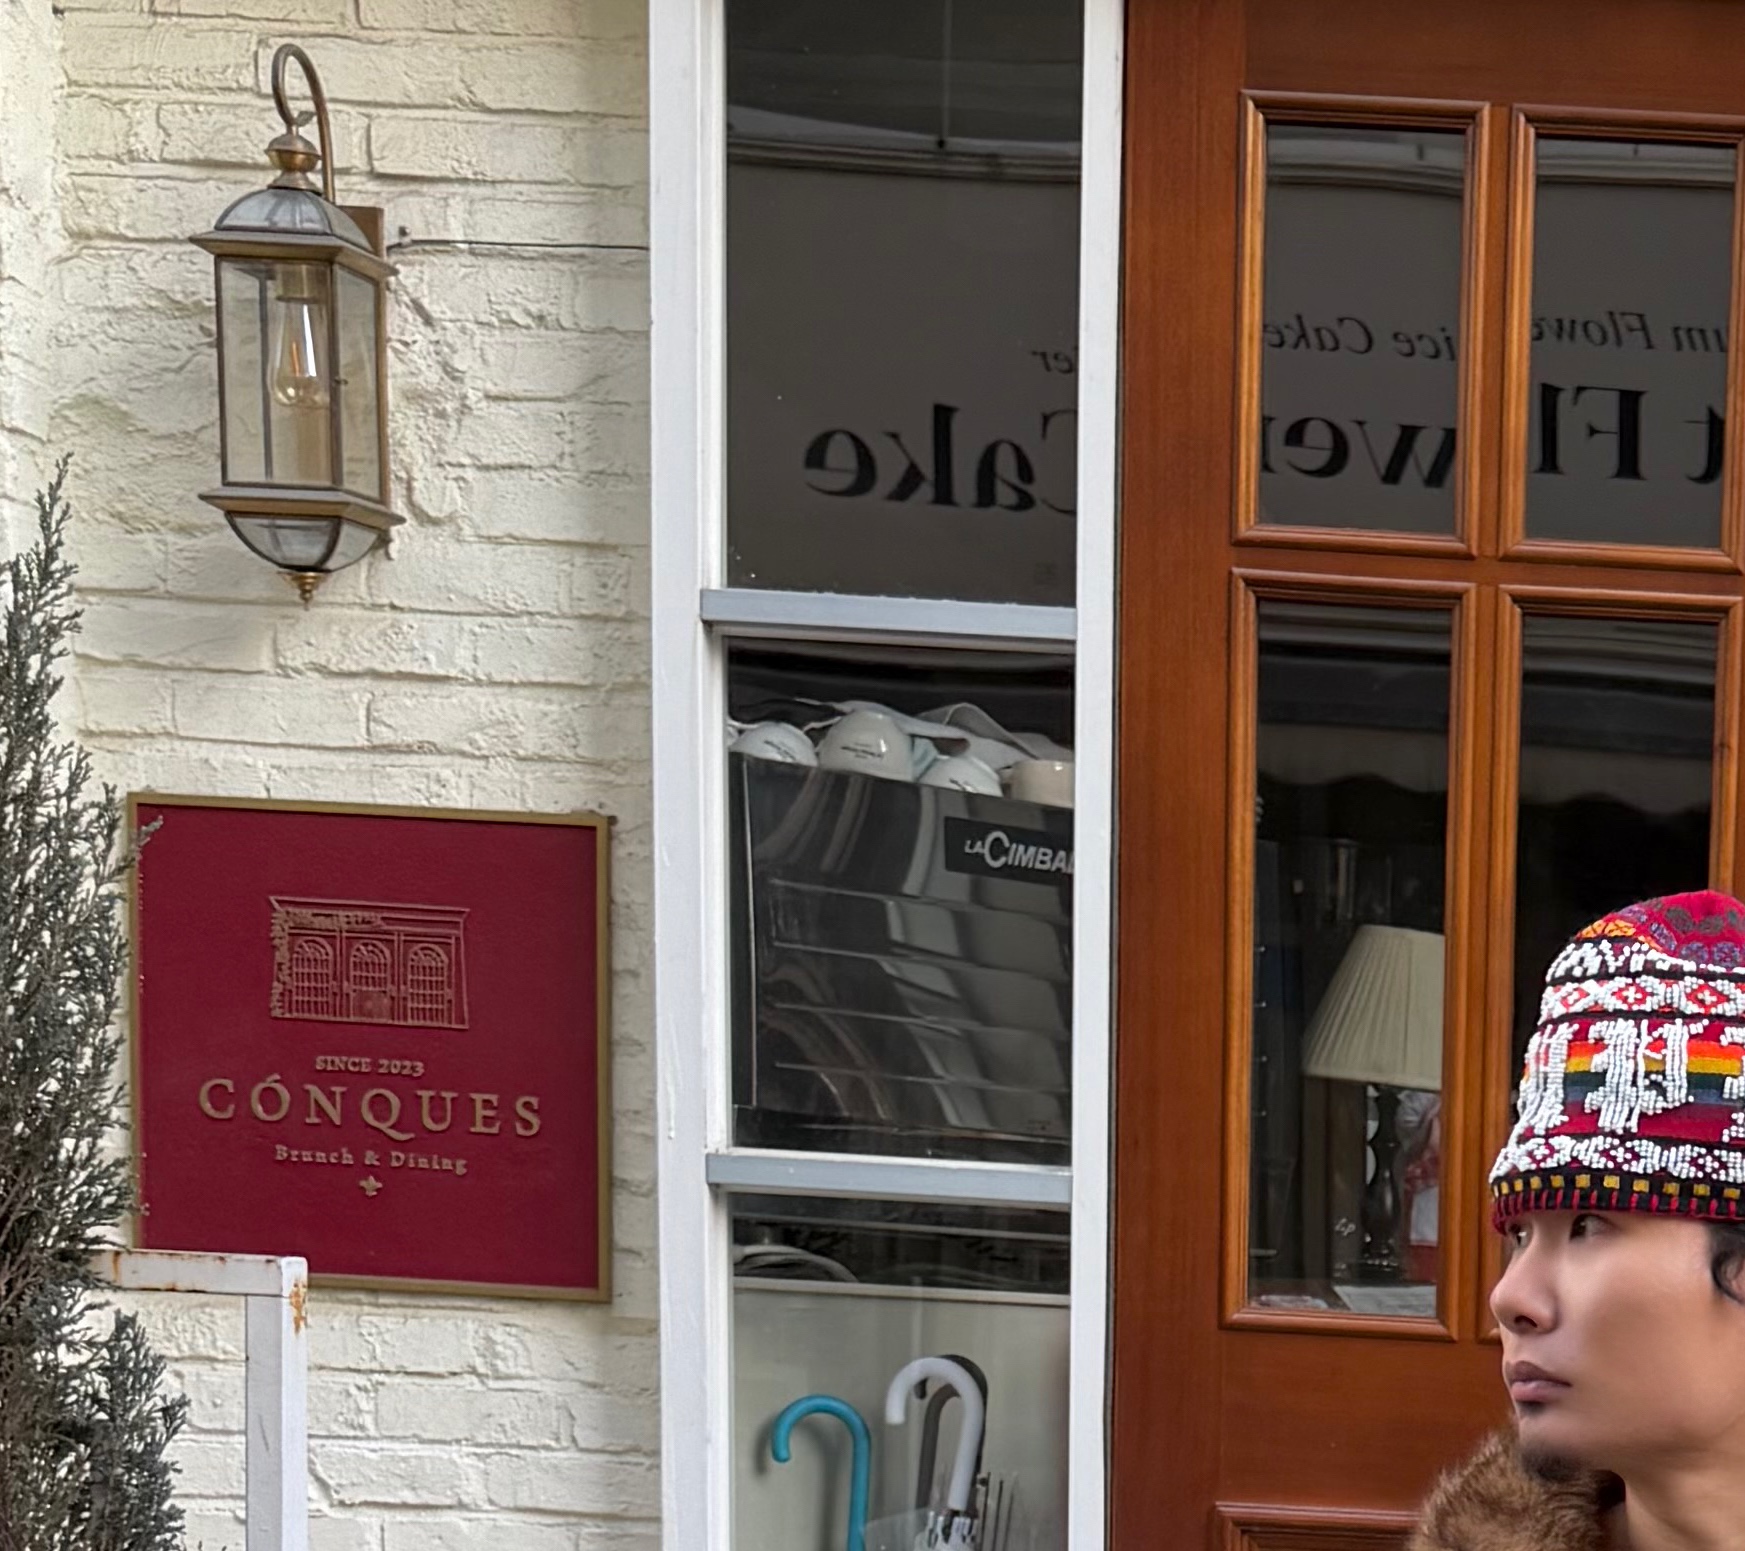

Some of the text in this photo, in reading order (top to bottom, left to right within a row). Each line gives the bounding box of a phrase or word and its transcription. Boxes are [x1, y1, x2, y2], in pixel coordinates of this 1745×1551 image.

[315, 1055, 425, 1077] SINCE 2023
[199, 1073, 542, 1141] CÓNQUES
[275, 1144, 468, 1175] Brunch & Dining
